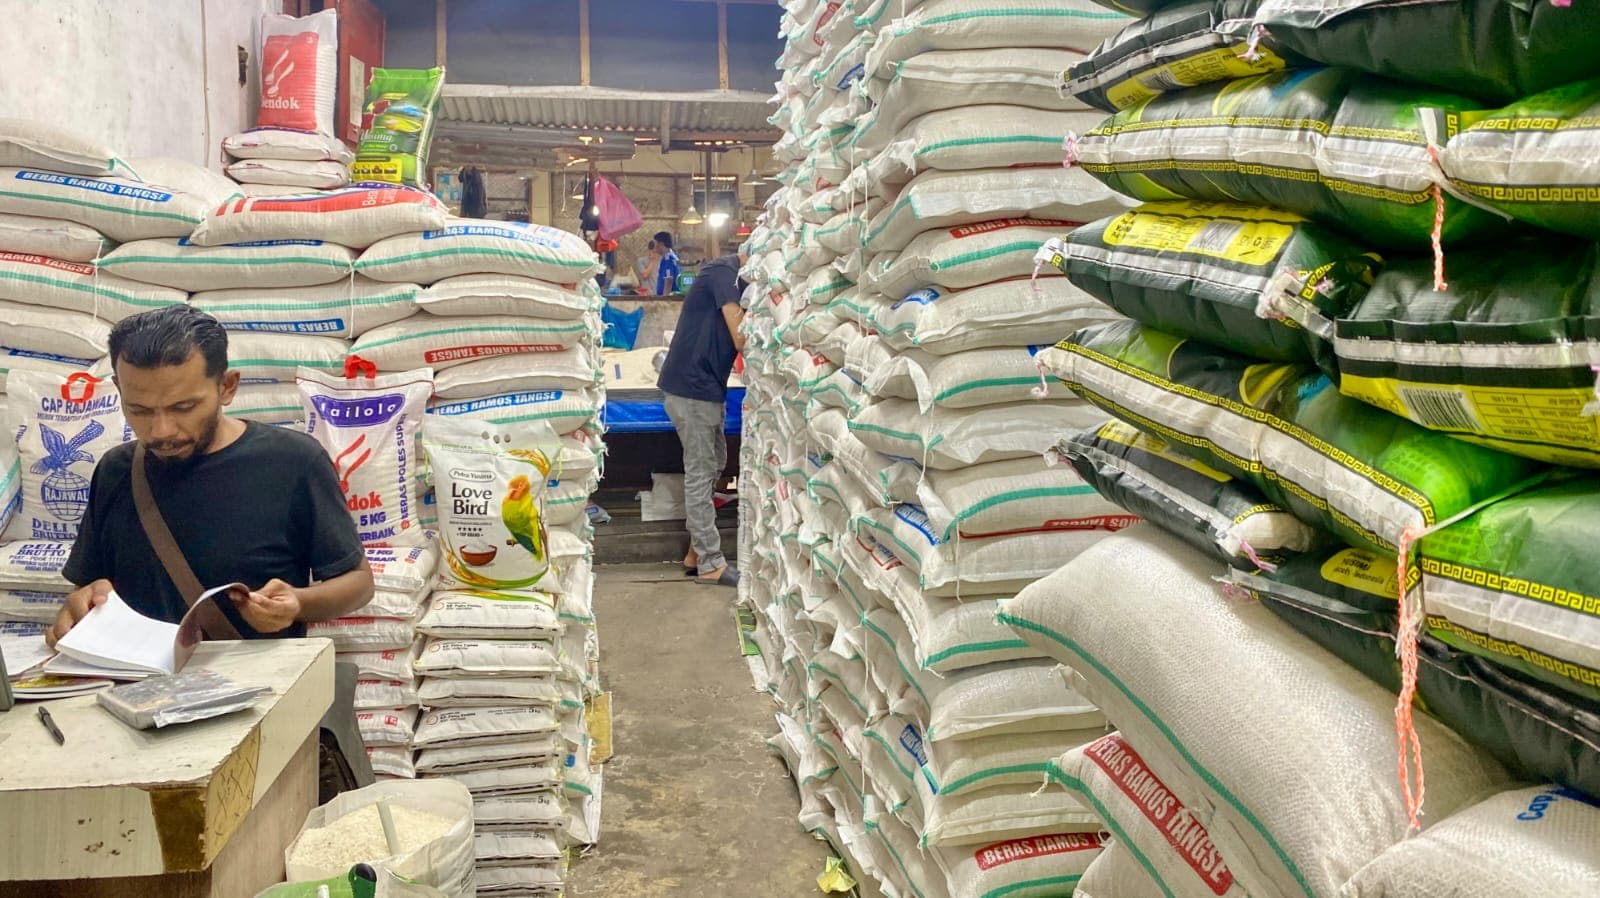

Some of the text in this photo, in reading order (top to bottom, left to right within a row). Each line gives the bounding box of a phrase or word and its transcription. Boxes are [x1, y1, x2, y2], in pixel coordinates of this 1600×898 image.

[23, 172, 167, 201] BERAS RAMOS TANGSE
[468, 226, 509, 237] RAMOS
[959, 218, 1006, 235] BERAS
[45, 257, 92, 274] TANGSE
[298, 321, 338, 332] BERAS
[431, 347, 477, 362] TANGSE
[477, 345, 519, 356] RAMOS
[41, 396, 63, 413] CAP
[65, 393, 119, 414] RAJAWALI
[471, 395, 512, 410] RAMOS
[515, 391, 556, 404] TANGSE
[398, 448, 406, 483] POLES
[45, 487, 89, 502] RAJAWAL
[451, 482, 493, 500] Love
[348, 491, 383, 511] dok
[399, 484, 409, 519] BERAS
[453, 499, 489, 515] Bird
[32, 517, 67, 532] DELI
[360, 511, 386, 526] 5 KG
[359, 526, 396, 541] ERBAIK
[1091, 737, 1228, 883] BERAS RAMOS TANGSE
[1516, 795, 1558, 821] Cap
[983, 832, 1090, 865] BERAS RAMOS
